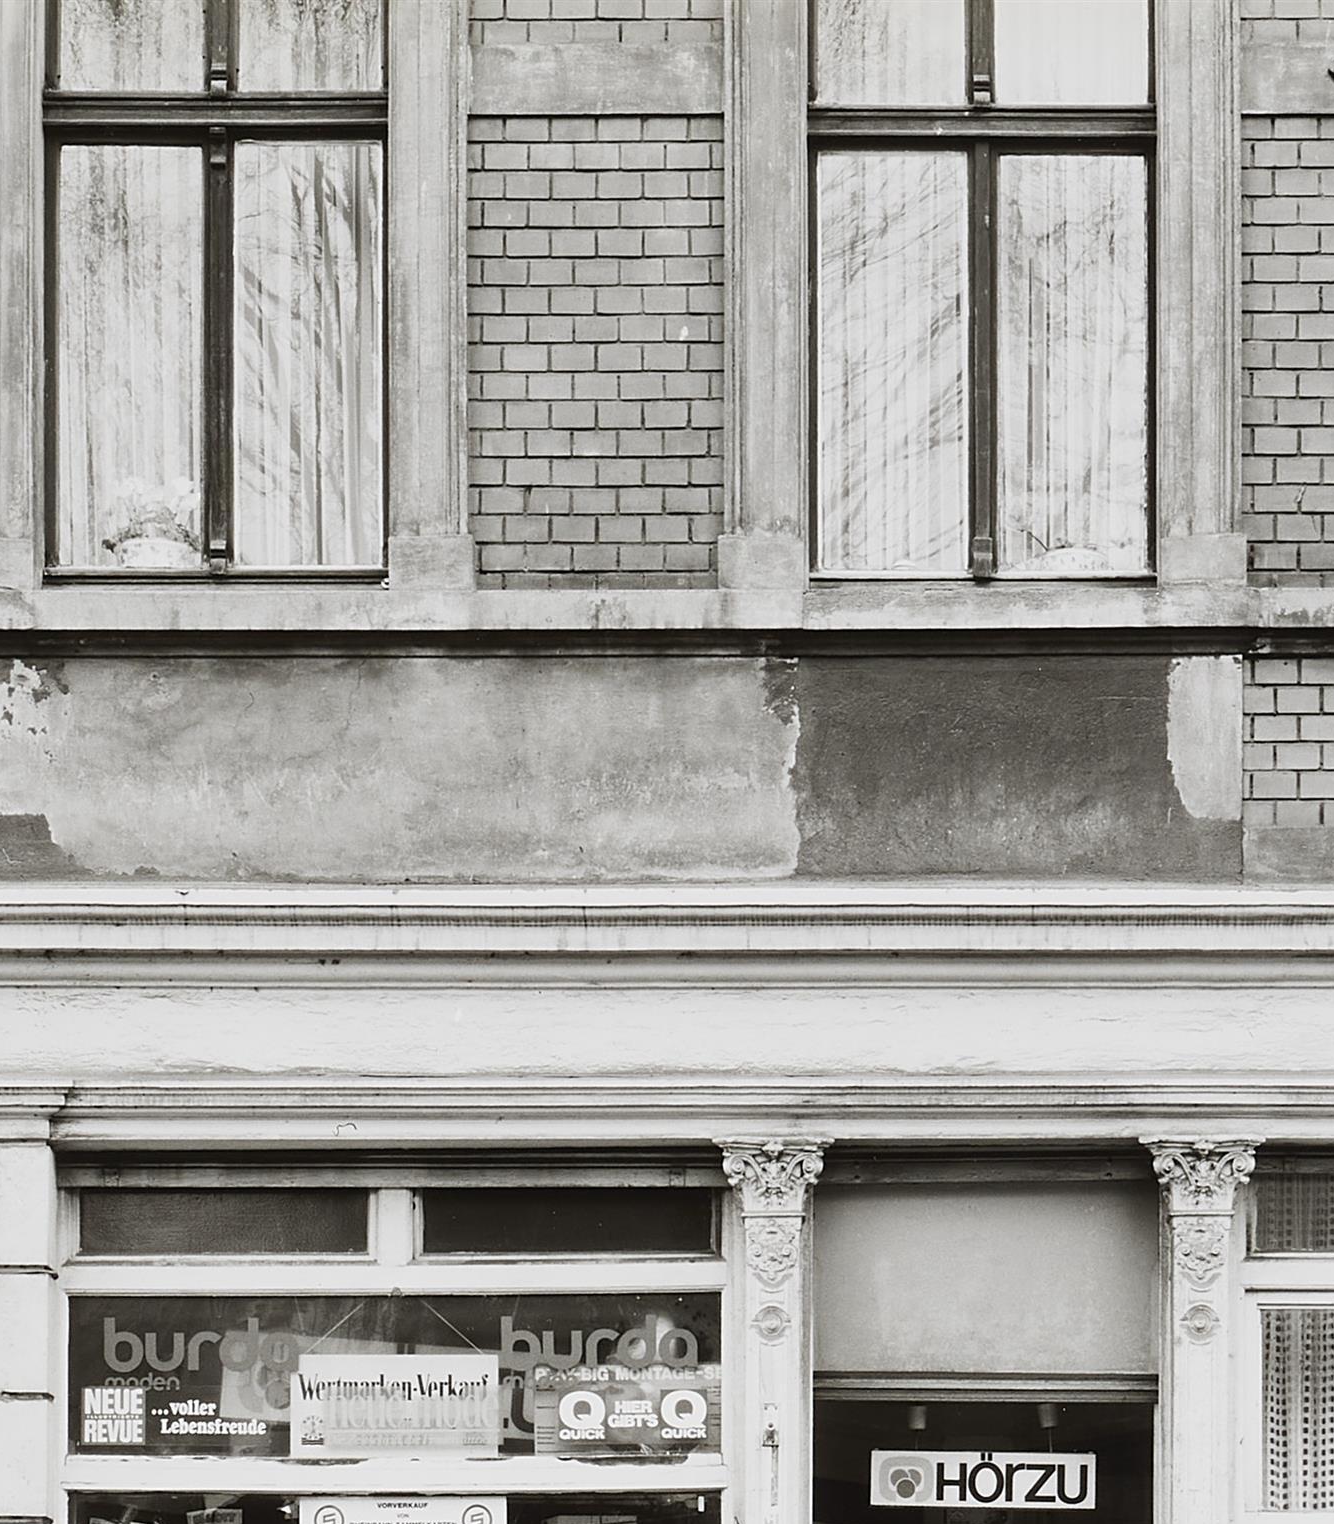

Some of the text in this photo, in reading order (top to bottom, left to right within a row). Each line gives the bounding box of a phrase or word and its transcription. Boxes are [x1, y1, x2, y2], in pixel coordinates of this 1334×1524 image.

[104, 1317, 298, 1373] burda
[500, 1315, 698, 1371] burda
[298, 1373, 489, 1402] Wertmarken-Verkauf
[84, 1388, 143, 1414] NEUE
[614, 1400, 653, 1413] HIER
[160, 1419, 267, 1436] Lebensfreude
[607, 1414, 659, 1428] GIBT'S
[84, 1420, 143, 1443] REVUE
[559, 1429, 606, 1440] QUICK
[661, 1428, 707, 1439] QUICK
